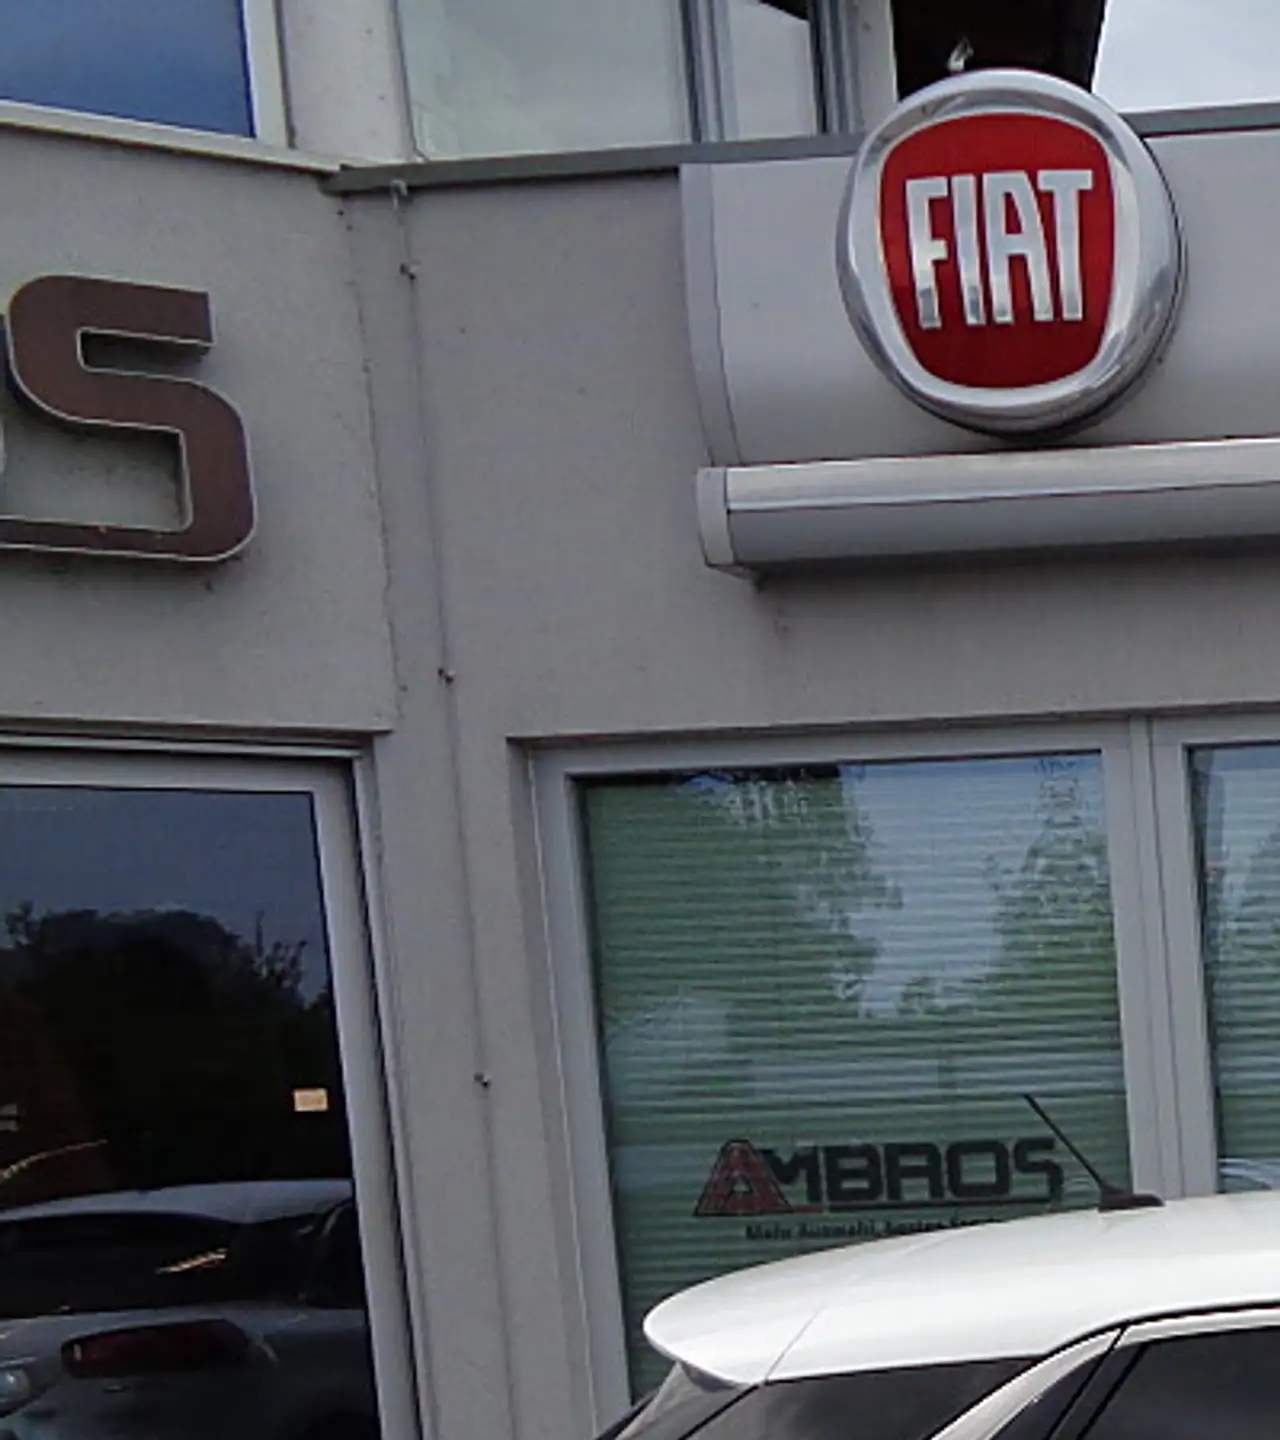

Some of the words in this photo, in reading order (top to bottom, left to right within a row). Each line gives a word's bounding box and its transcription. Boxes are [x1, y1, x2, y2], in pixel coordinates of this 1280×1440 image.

[905, 169, 1094, 330] FIAT
[0, 273, 255, 562] S
[694, 1138, 1066, 1217] AMBROS
